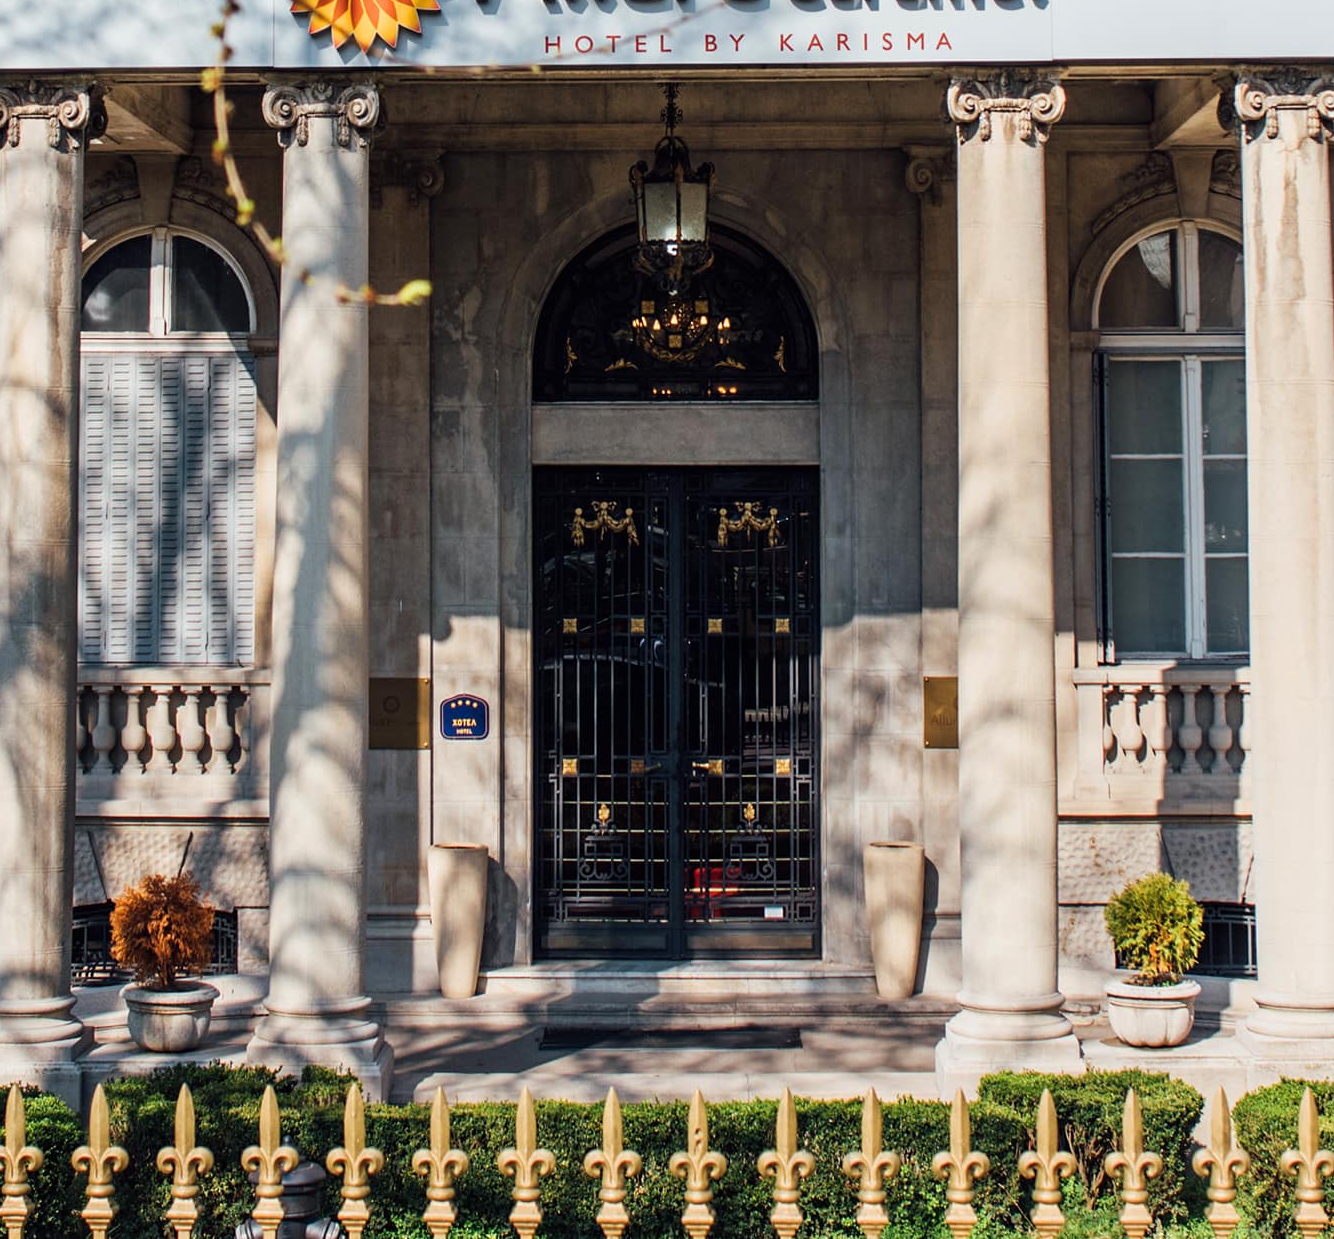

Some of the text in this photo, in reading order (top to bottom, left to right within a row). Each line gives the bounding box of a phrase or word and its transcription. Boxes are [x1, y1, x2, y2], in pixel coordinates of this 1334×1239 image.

[545, 33, 953, 53] HOTEL BY KARISMA
